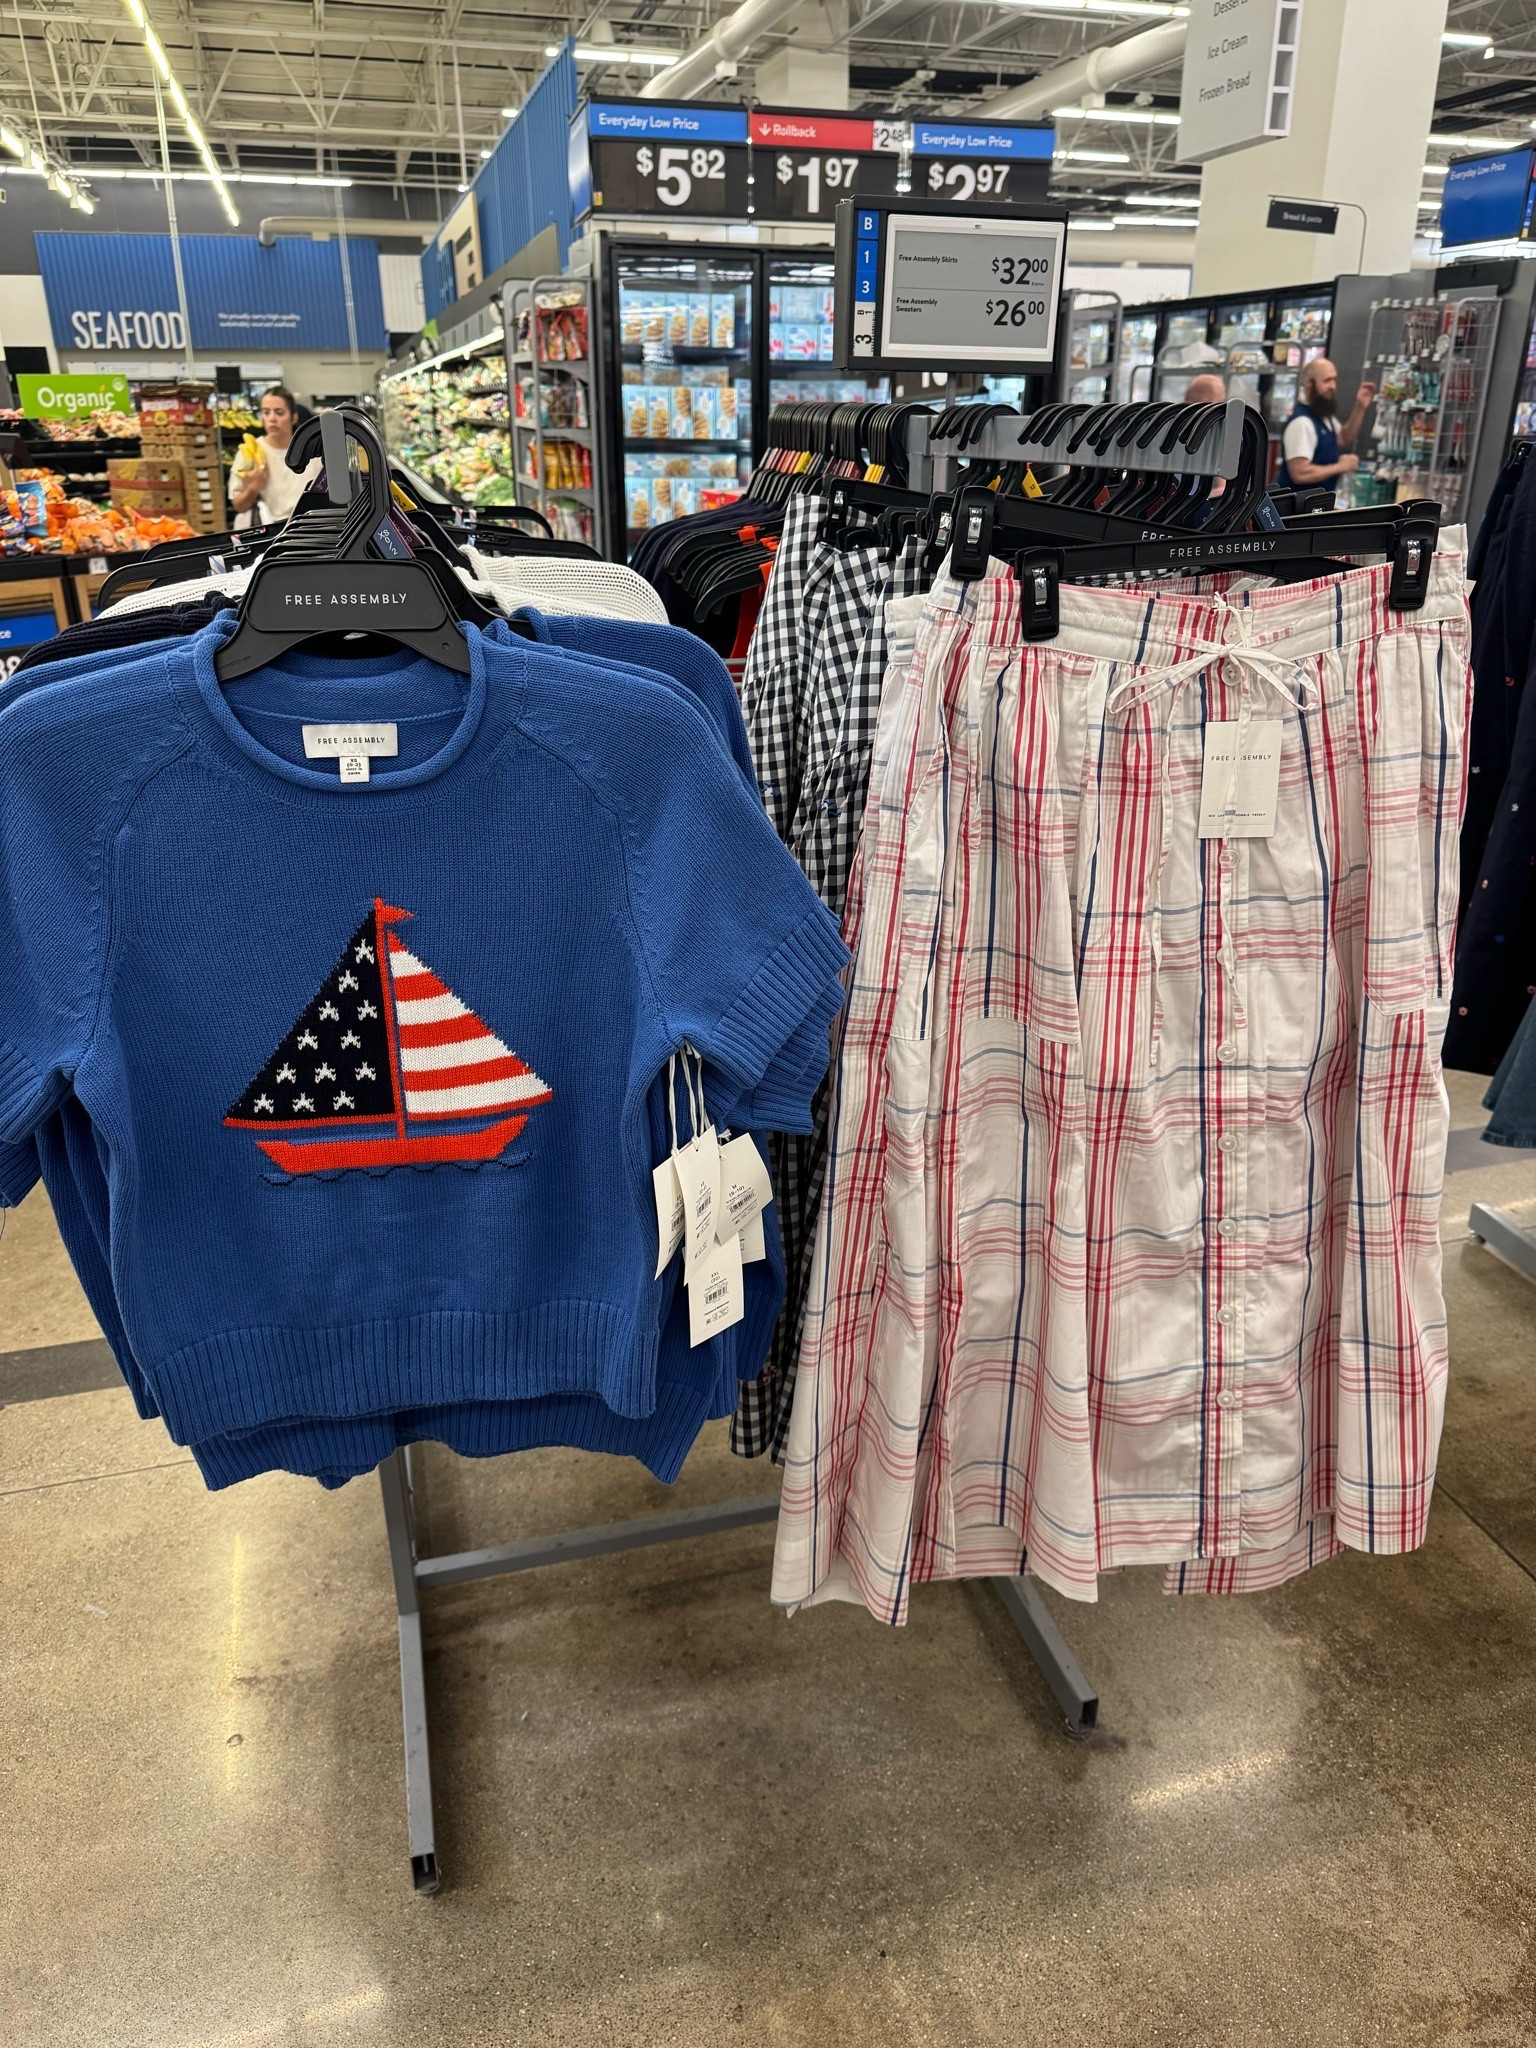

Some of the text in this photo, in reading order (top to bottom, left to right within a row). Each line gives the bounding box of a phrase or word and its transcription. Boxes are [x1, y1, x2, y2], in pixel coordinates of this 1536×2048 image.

[1207, 35, 1248, 59] Ice Cream
[1199, 71, 1251, 103] Frozen Bread
[599, 113, 700, 131] Everyday Low Price
[772, 124, 817, 138] Rollback
[921, 132, 1013, 148] Everyday Low Price
[1451, 168, 1476, 180] Everyday
[1491, 162, 1506, 172] Price
[864, 217, 873, 230] B
[864, 250, 869, 263] 1
[913, 256, 941, 264] Assembly
[862, 281, 870, 294] 3
[71, 311, 187, 350] SEAFOOD
[855, 334, 872, 344] 3
[37, 385, 116, 413] Organic
[1142, 531, 1174, 540] FR
[1169, 541, 1276, 558] FREE ASSEMBLY
[285, 593, 407, 606] FREE ASSEMBLY
